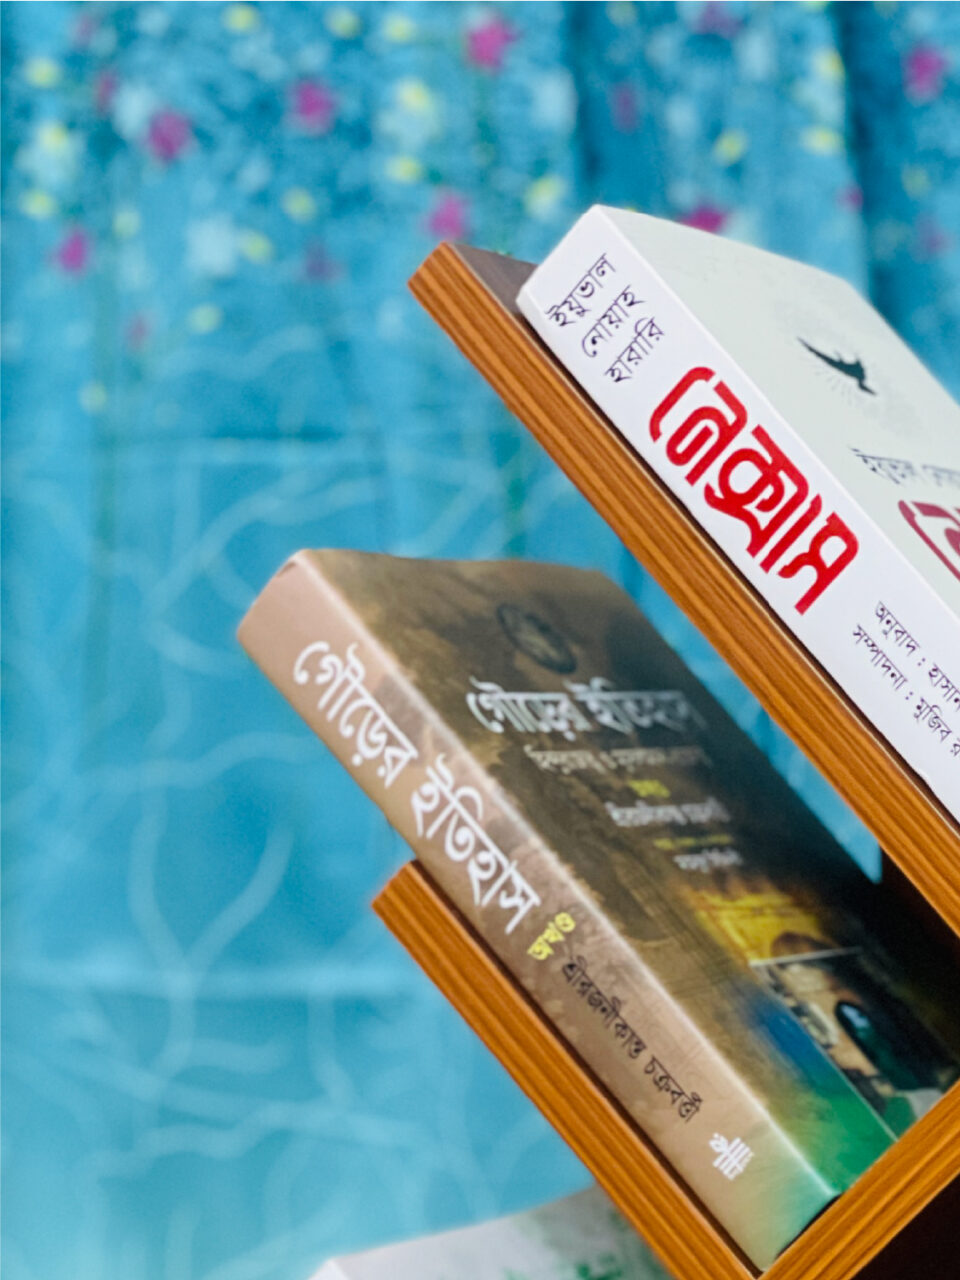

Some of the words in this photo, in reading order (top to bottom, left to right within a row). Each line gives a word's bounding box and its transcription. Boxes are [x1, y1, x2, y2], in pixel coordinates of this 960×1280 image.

[581, 284, 647, 358] নোয়াহ
[604, 317, 665, 383] হারারি
[649, 366, 859, 615] নেক্সাস
[875, 601, 920, 655] অনুবাদ
[852, 624, 908, 691] সম্পাদনা
[913, 697, 952, 742] মুজিব
[294, 640, 419, 789] গৌড়ের
[411, 754, 541, 934] ইতিহাস
